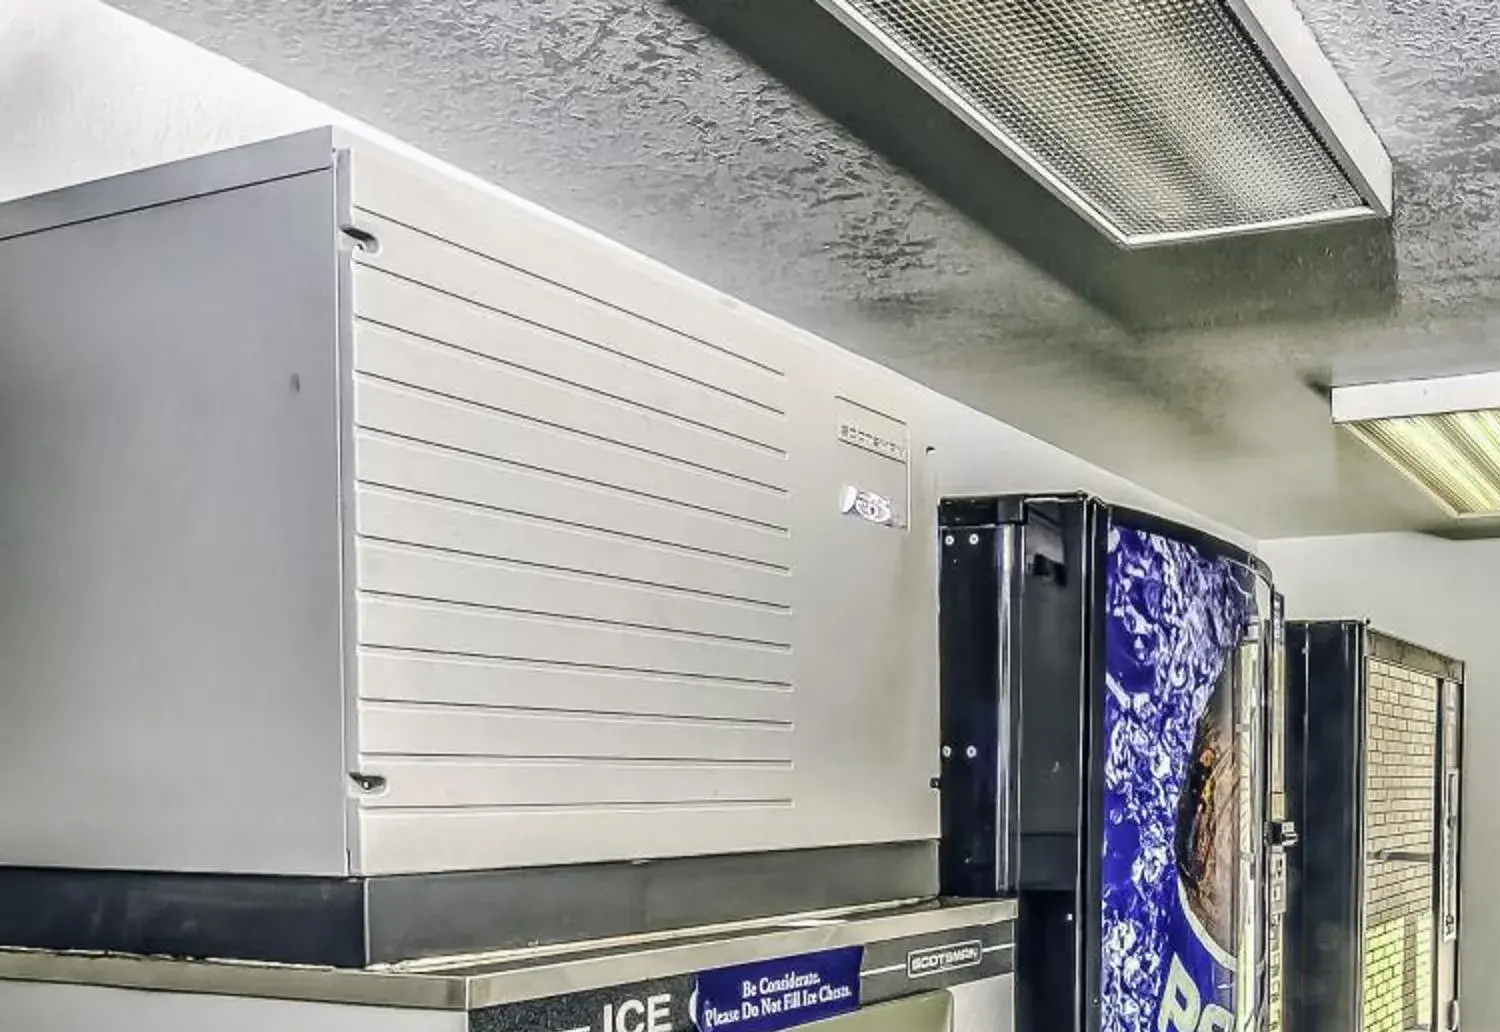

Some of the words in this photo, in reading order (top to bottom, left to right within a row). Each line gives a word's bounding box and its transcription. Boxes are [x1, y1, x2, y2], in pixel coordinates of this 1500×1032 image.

[742, 980, 757, 999] Be
[705, 1007, 740, 1027] Please
[741, 1001, 759, 1020] Do
[761, 997, 782, 1015] Not
[783, 991, 801, 1011] Fill
